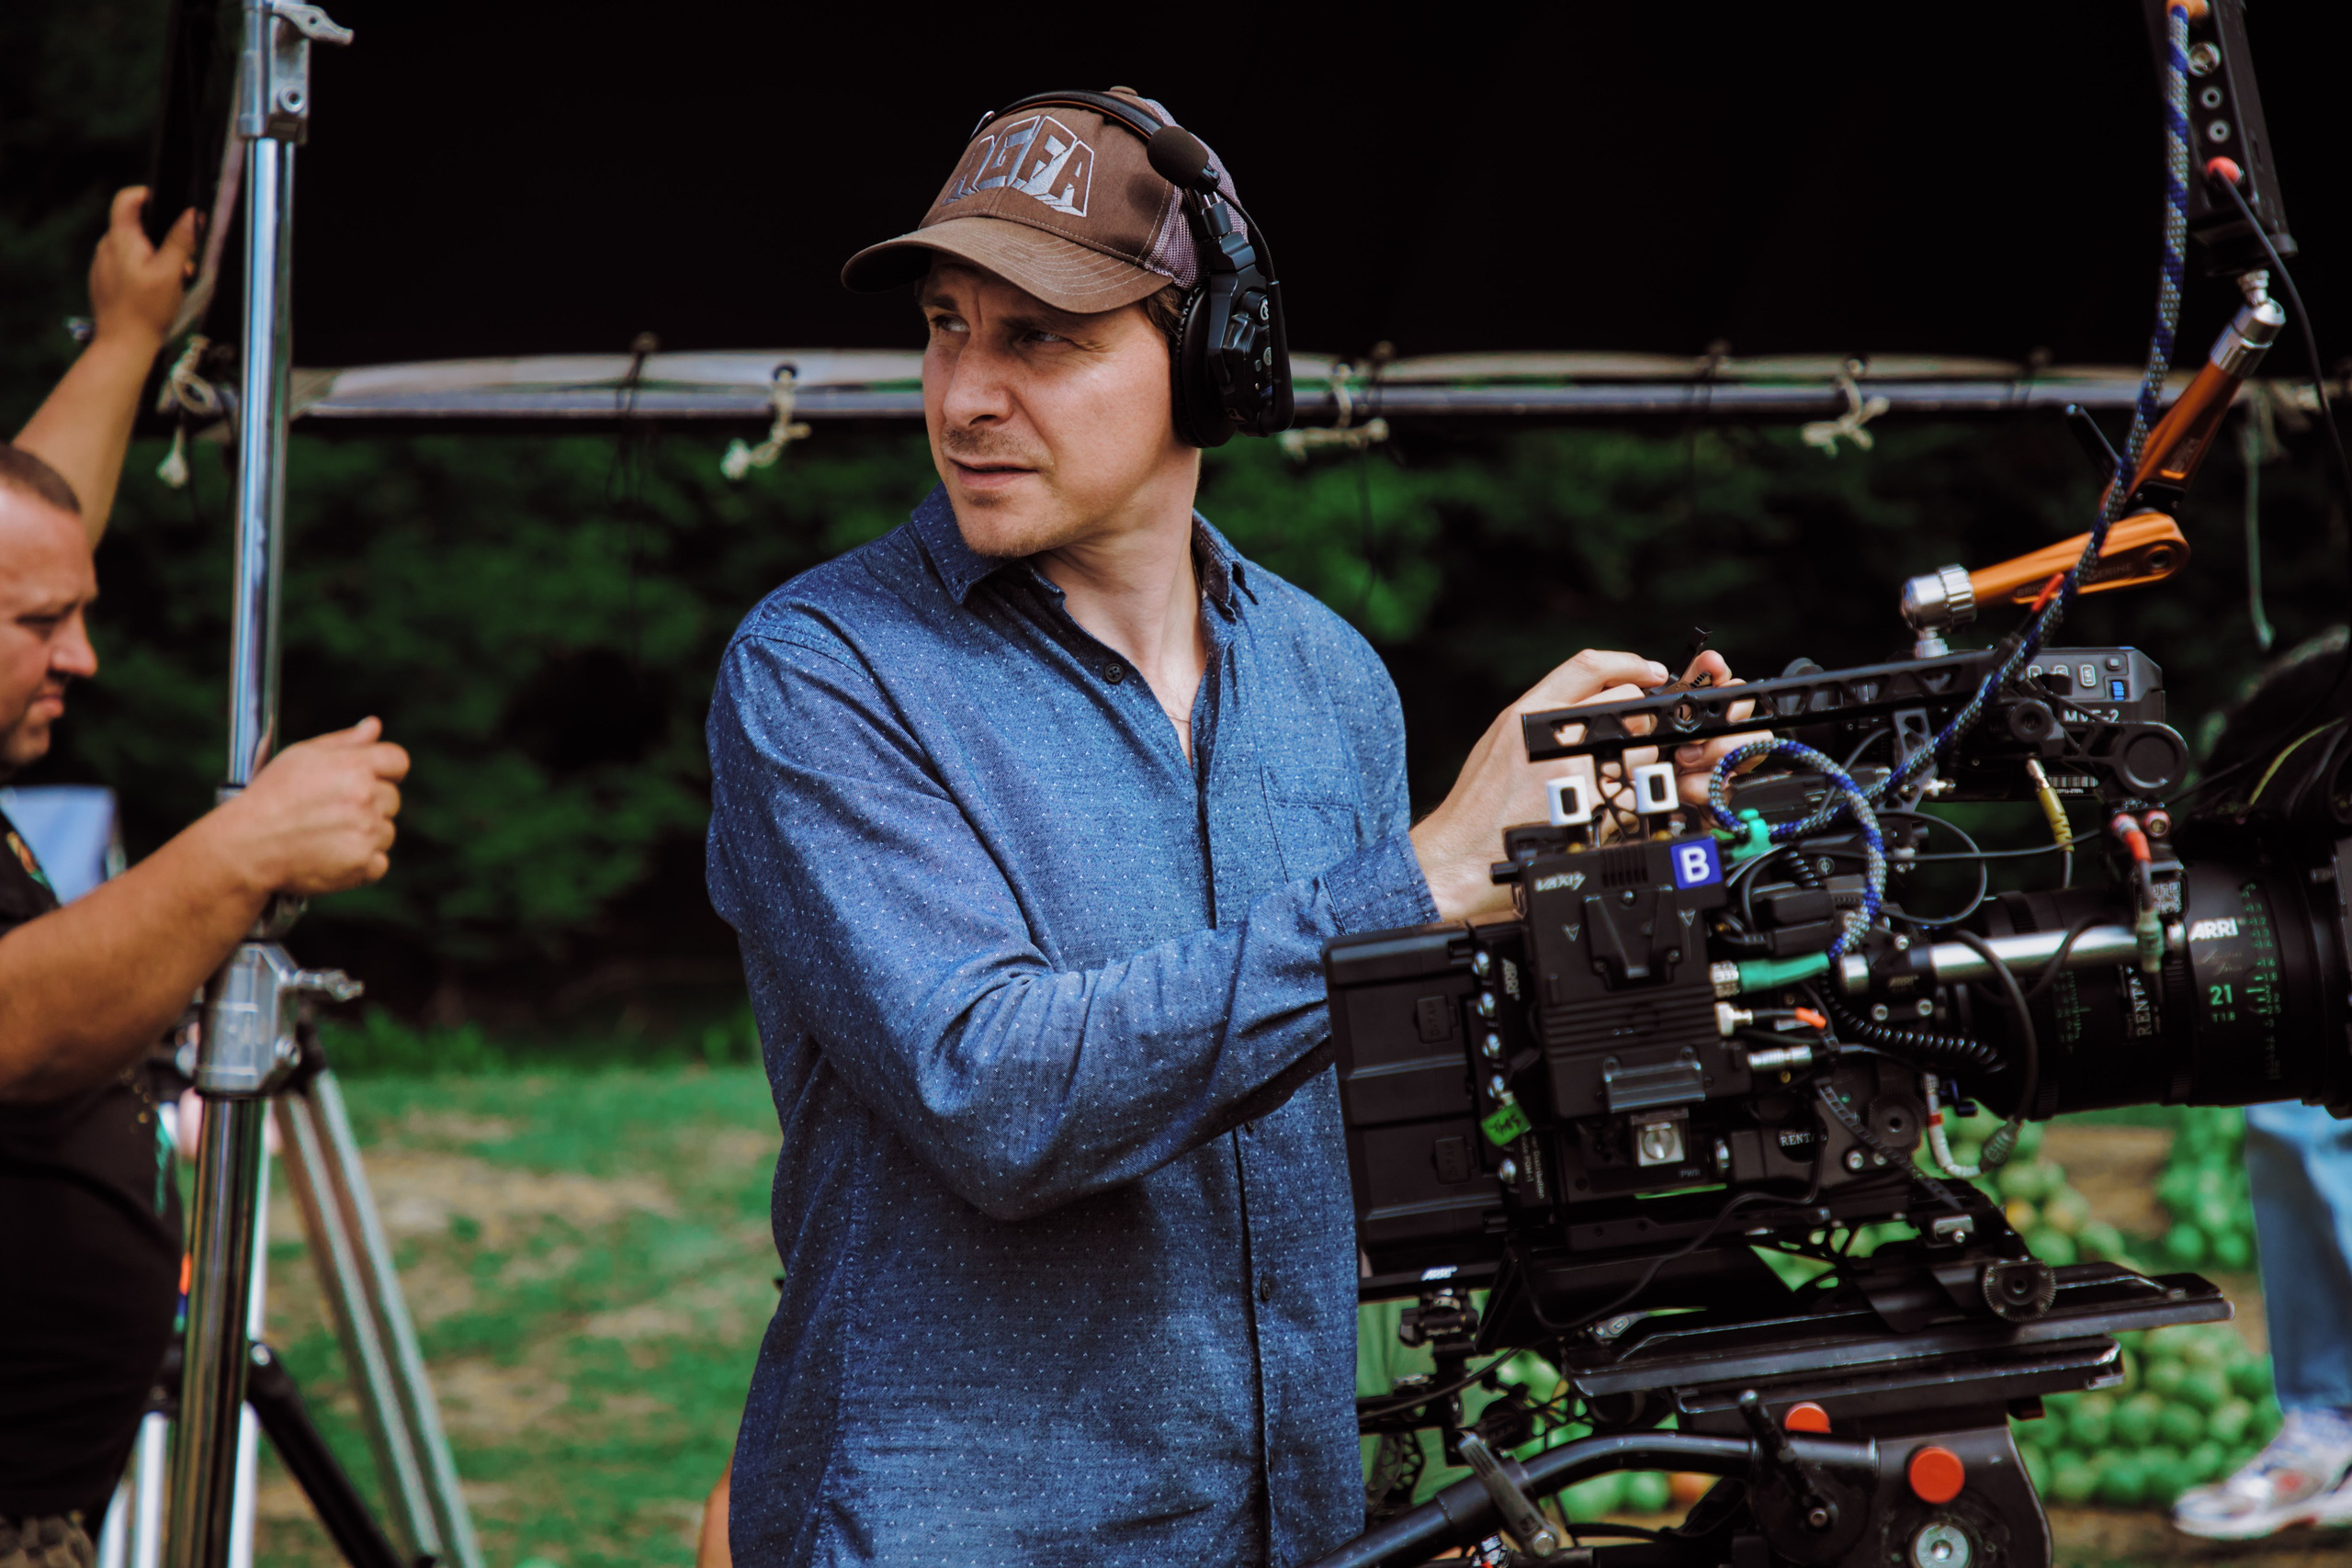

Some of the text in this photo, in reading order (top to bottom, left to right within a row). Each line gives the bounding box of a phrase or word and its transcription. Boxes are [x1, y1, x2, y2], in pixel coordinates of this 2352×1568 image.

[1679, 845, 1711, 884] B
[2188, 917, 2238, 942] ARRI
[1501, 956, 1520, 996] ARRI
[2209, 983, 2233, 1006] 21
[1781, 1132, 1815, 1147] RENT
[1679, 1168, 1701, 1179] PWR
